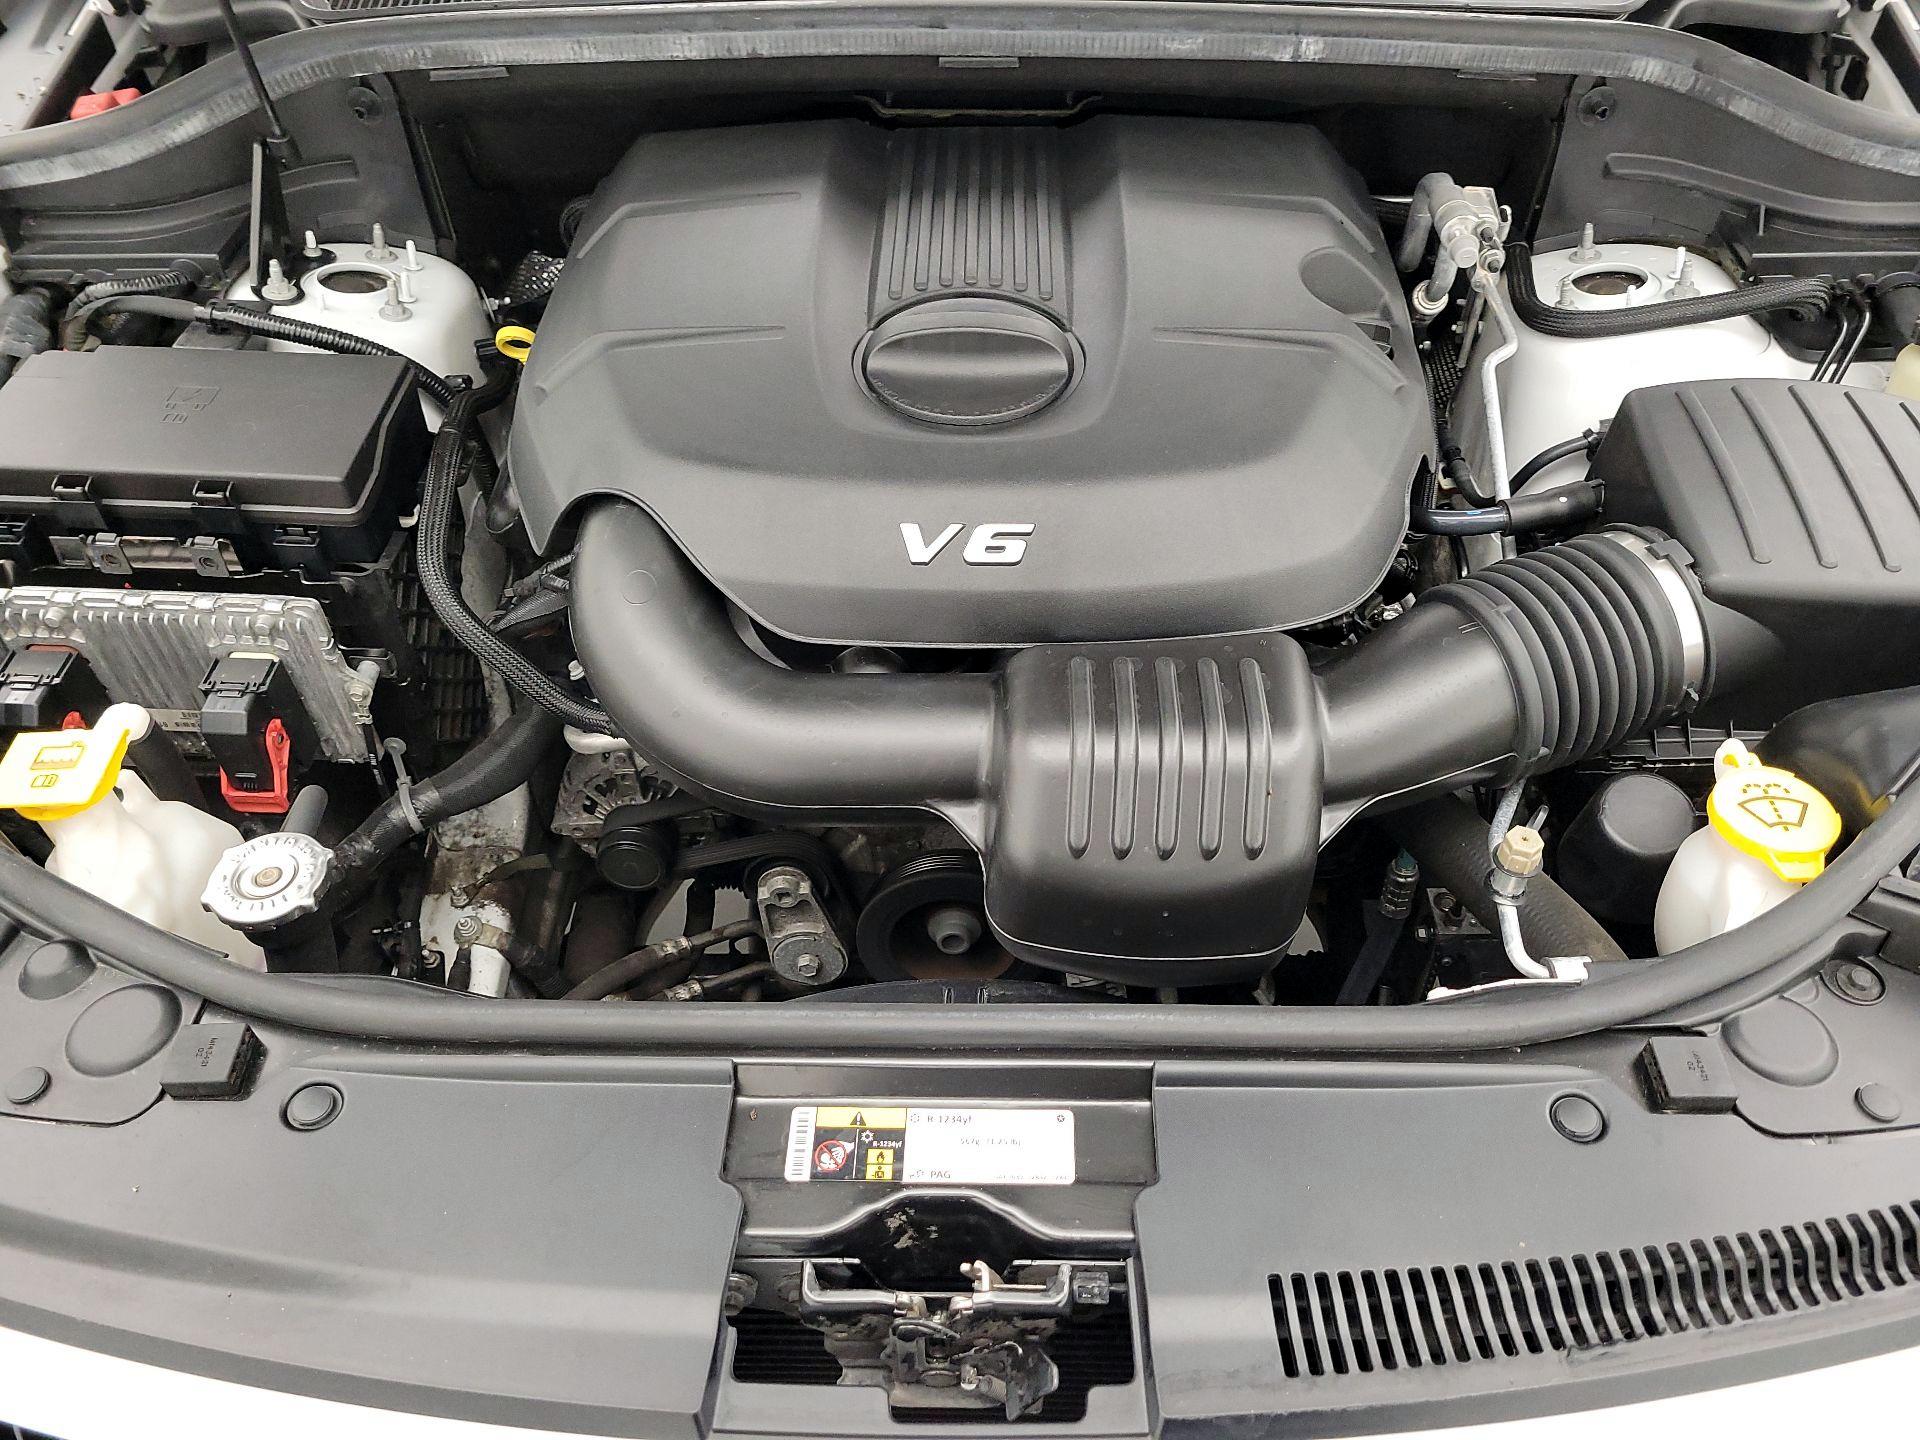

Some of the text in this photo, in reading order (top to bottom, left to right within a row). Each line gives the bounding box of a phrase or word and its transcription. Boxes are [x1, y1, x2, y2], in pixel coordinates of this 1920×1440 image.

[899, 522, 1036, 566] V6
[927, 1115, 972, 1125] R1234yf
[872, 1140, 903, 1149] R-1234yf
[930, 1170, 951, 1179] PAG
